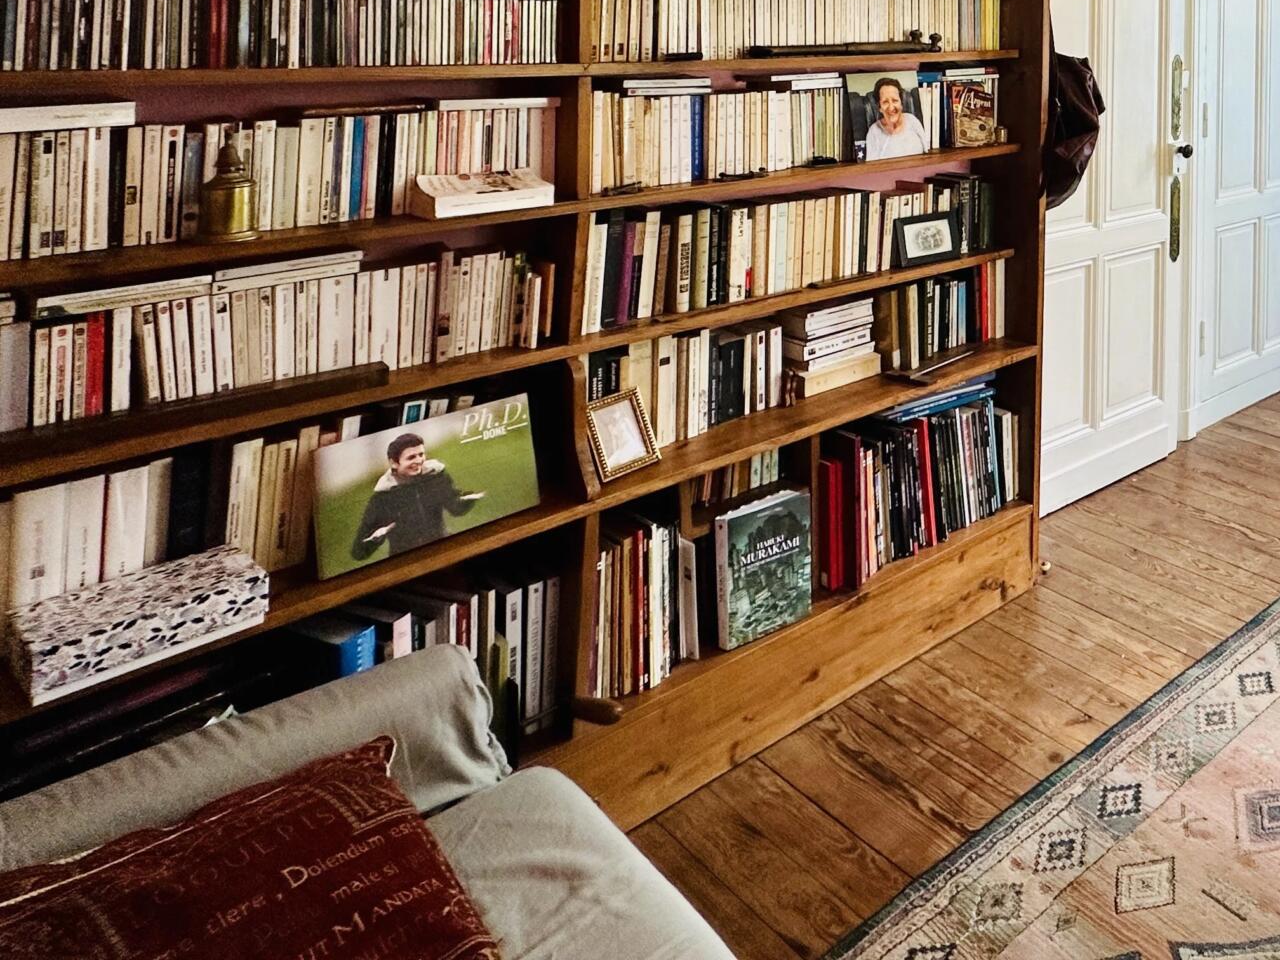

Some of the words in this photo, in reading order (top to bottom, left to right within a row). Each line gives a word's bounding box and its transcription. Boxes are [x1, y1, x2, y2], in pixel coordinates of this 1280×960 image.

[462, 402, 527, 437] Ph.D.
[482, 425, 507, 441] DONE
[740, 536, 800, 567] MURAKAMI
[756, 534, 785, 551] HARUKI
[281, 833, 385, 889] Dolendum
